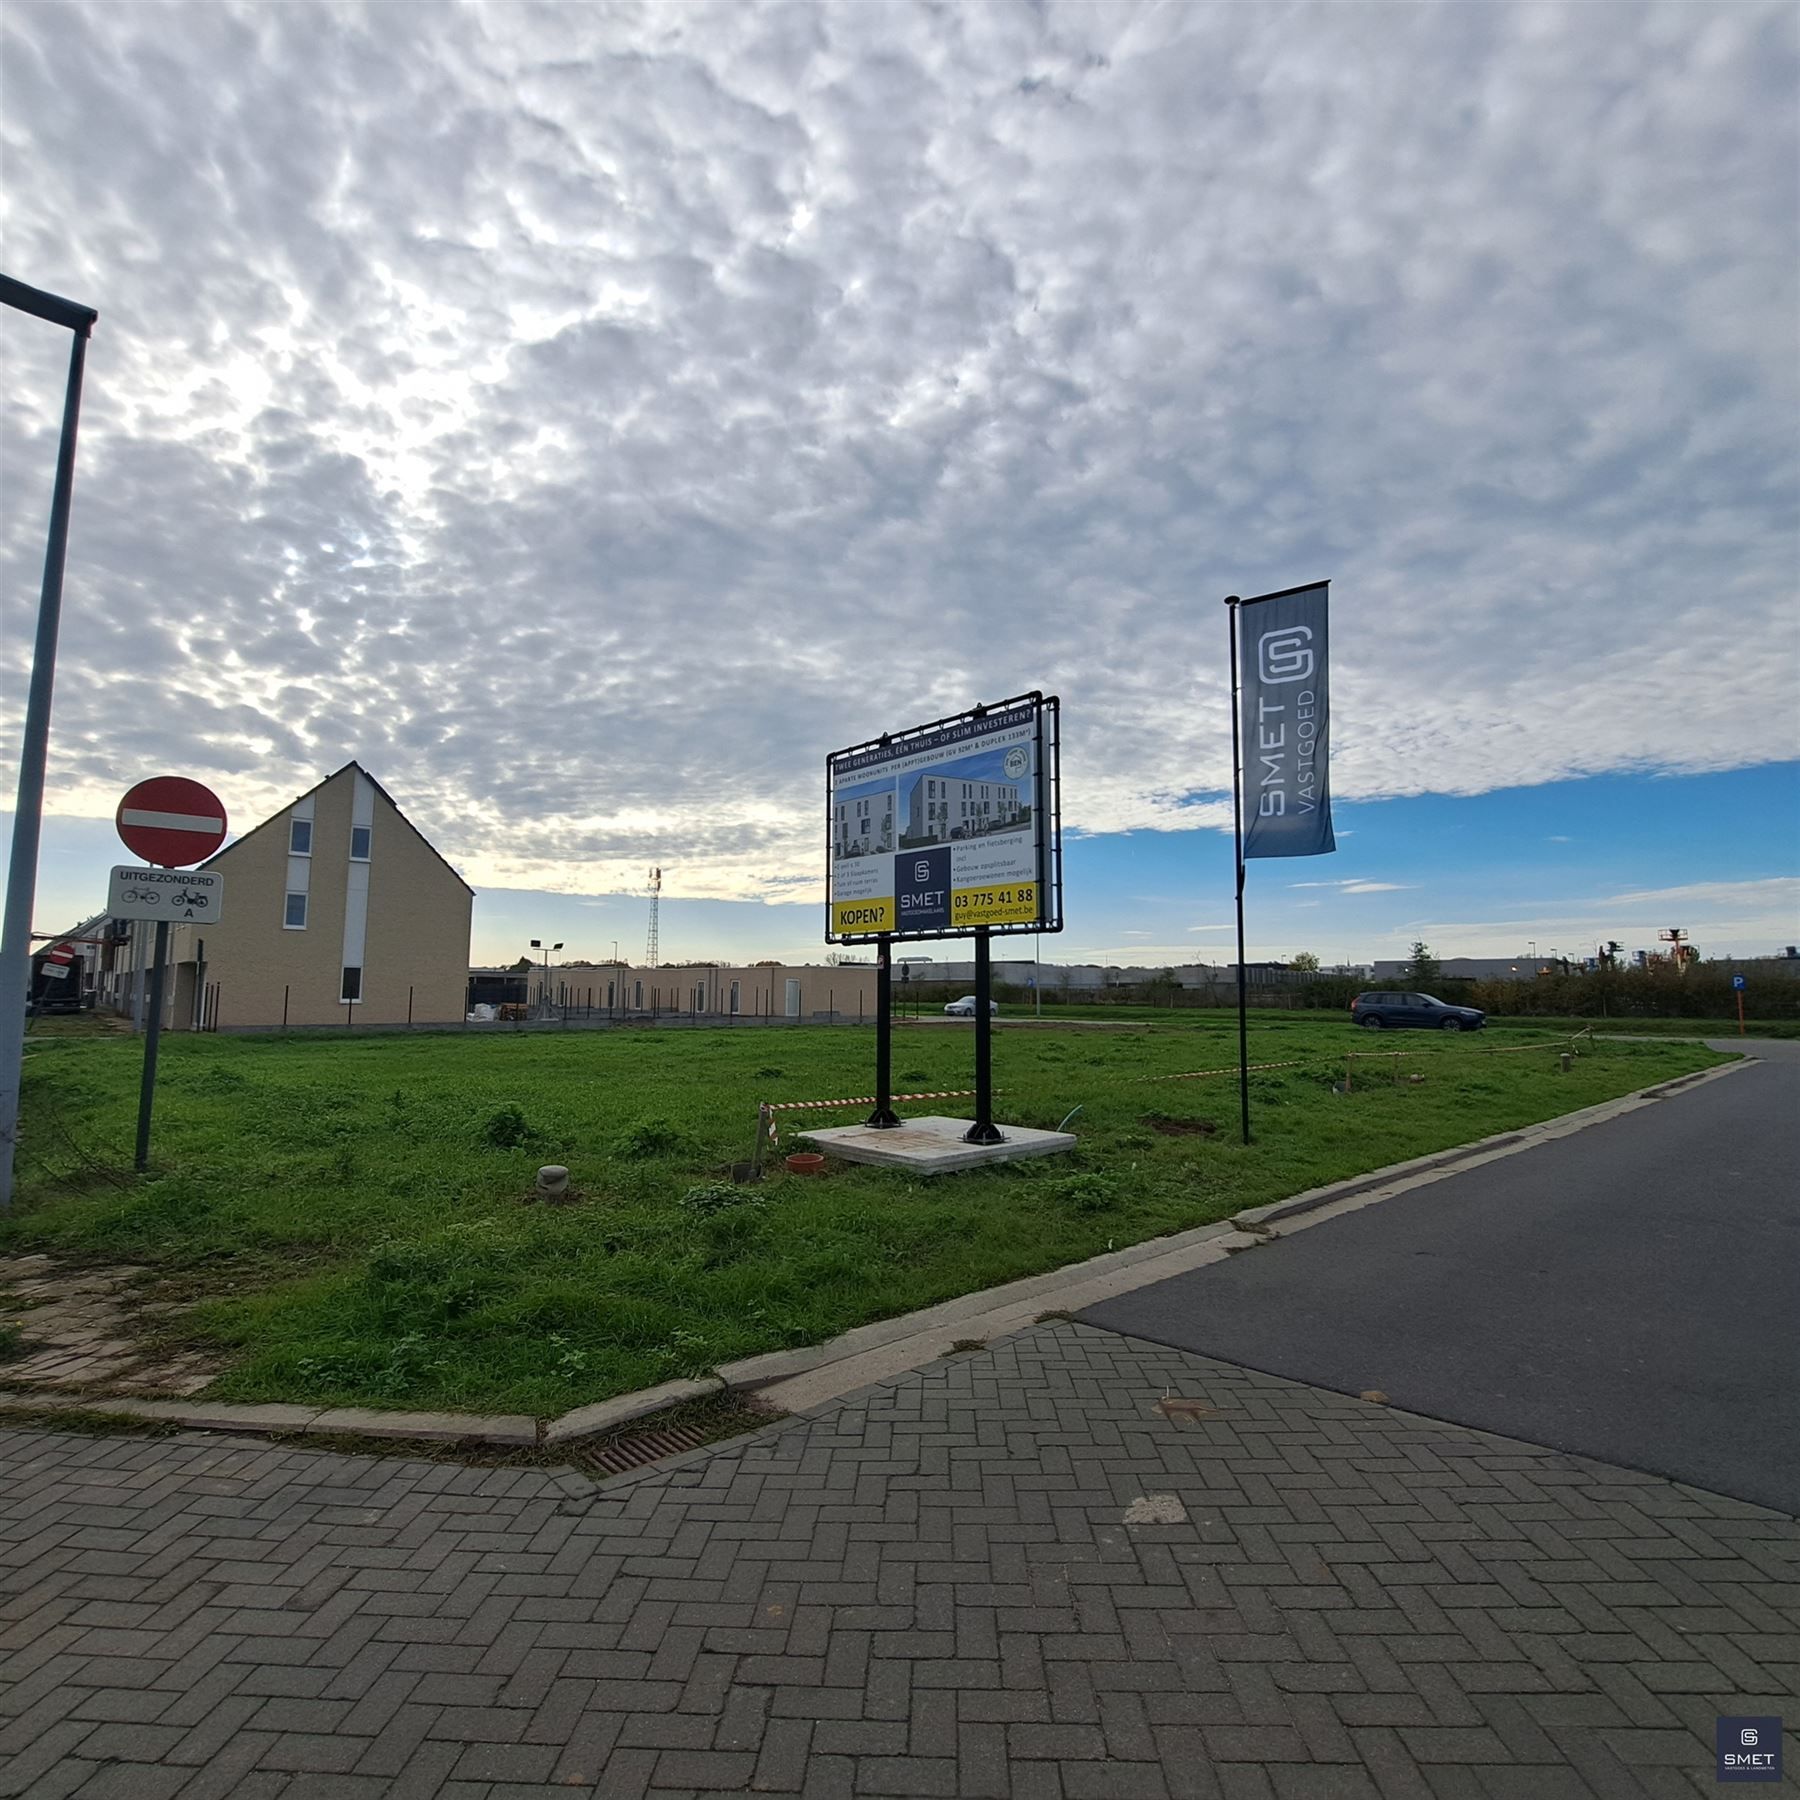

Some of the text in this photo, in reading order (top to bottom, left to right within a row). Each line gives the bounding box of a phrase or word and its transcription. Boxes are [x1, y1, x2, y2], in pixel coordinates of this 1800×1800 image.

[835, 760, 851, 771] TWEE
[853, 750, 893, 766] GENERATIES,
[911, 738, 931, 750] THUIS
[940, 733, 950, 743] OF
[952, 726, 971, 739] SLIM
[974, 710, 1030, 731] INVESTEREN?
[1259, 697, 1285, 816] SMET
[1297, 690, 1315, 814] VASTGOED
[956, 843, 977, 852] Parking
[956, 864, 978, 872] Gebouw
[1006, 867, 1032, 877] mogelijk
[120, 871, 214, 886] UITGEZONDERD
[900, 890, 945, 908] SMET
[954, 888, 1033, 908] 03 775 41 88
[184, 908, 193, 917] A
[840, 906, 885, 926] KOPEN?
[954, 904, 1033, 921] guy@vastgoed-smet.be
[1733, 976, 1744, 988] P
